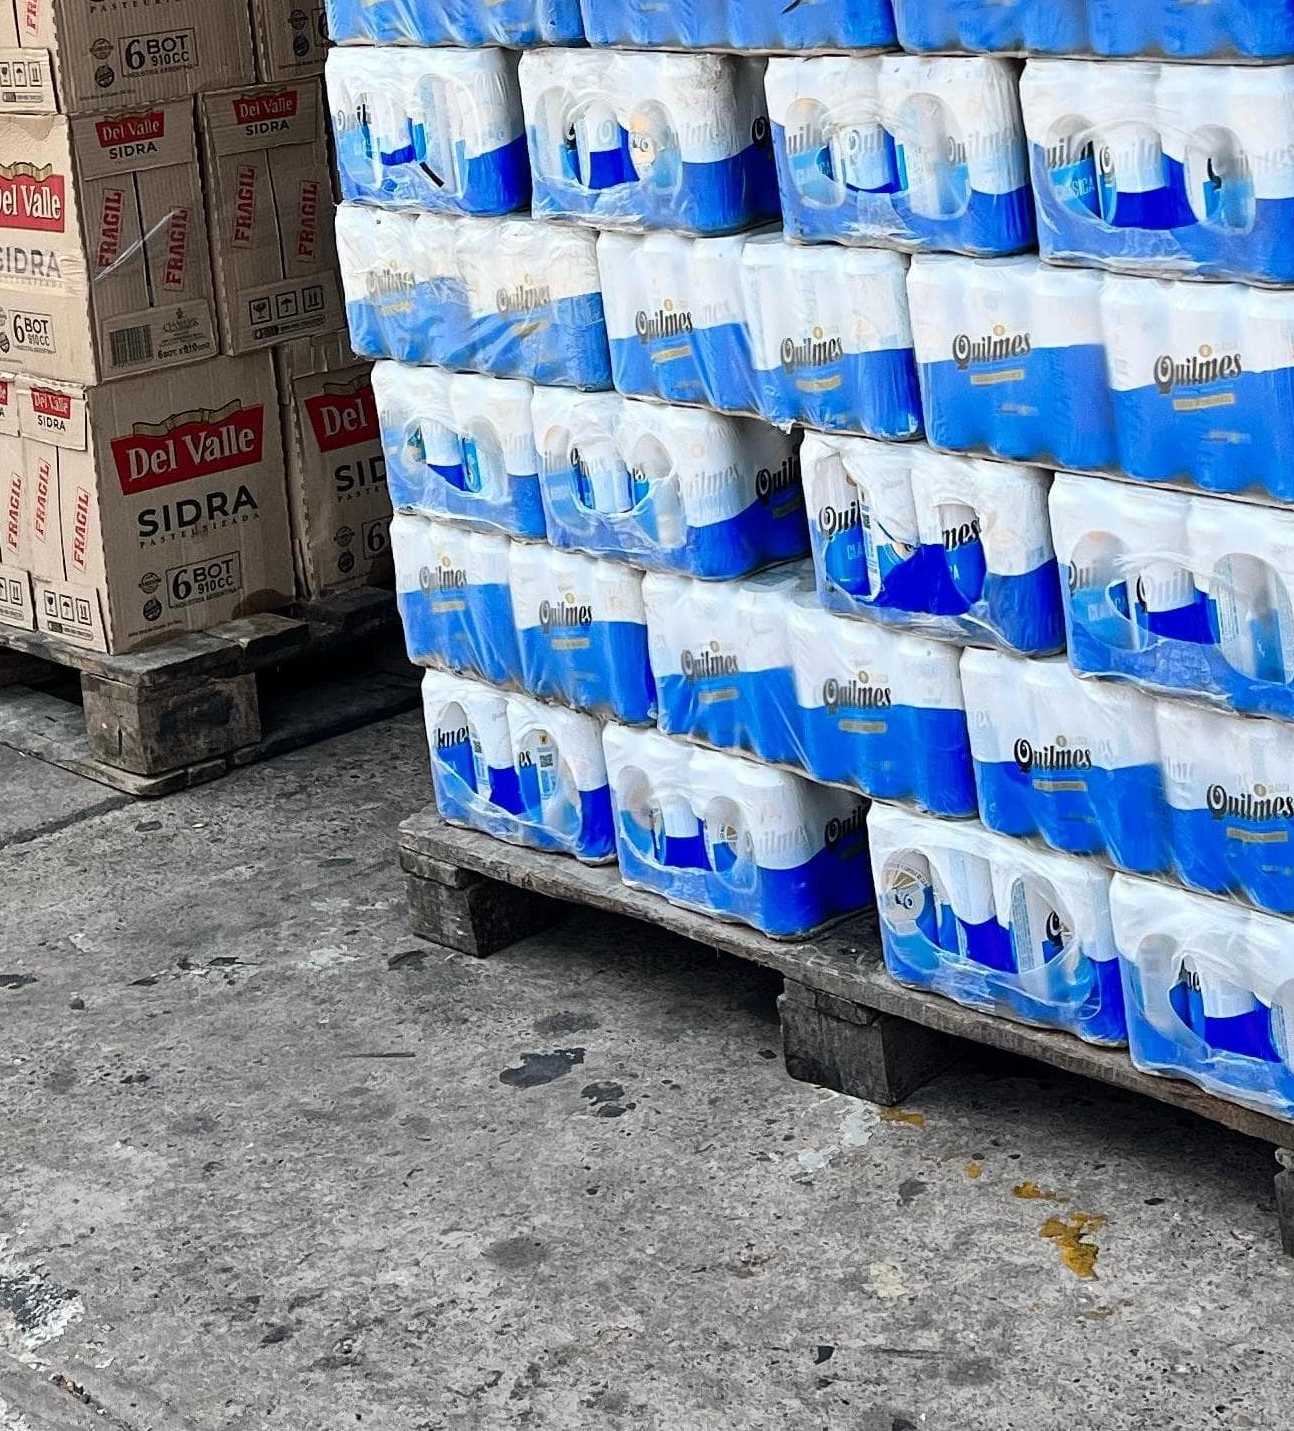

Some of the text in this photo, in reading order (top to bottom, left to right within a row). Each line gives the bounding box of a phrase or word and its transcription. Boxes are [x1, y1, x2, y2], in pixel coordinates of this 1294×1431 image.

[124, 34, 188, 70] 6 BOT
[151, 51, 189, 66] 910CC
[246, 119, 290, 135] SIDRA
[23, 186, 61, 220] Valle
[635, 307, 693, 342] Quilmes
[781, 335, 842, 369] Quilmes
[952, 330, 1031, 370] Quilmes
[1155, 351, 1242, 395] Quilmes
[37, 416, 66, 432] SIDRA
[126, 424, 255, 481] Del Valle
[138, 485, 258, 538] SIDRA
[172, 558, 234, 600] 6 BOT
[197, 574, 234, 595] 910CC
[823, 677, 891, 713] Quilmes
[1015, 737, 1092, 772] Quilmes
[1207, 783, 1294, 821] Quilmes
